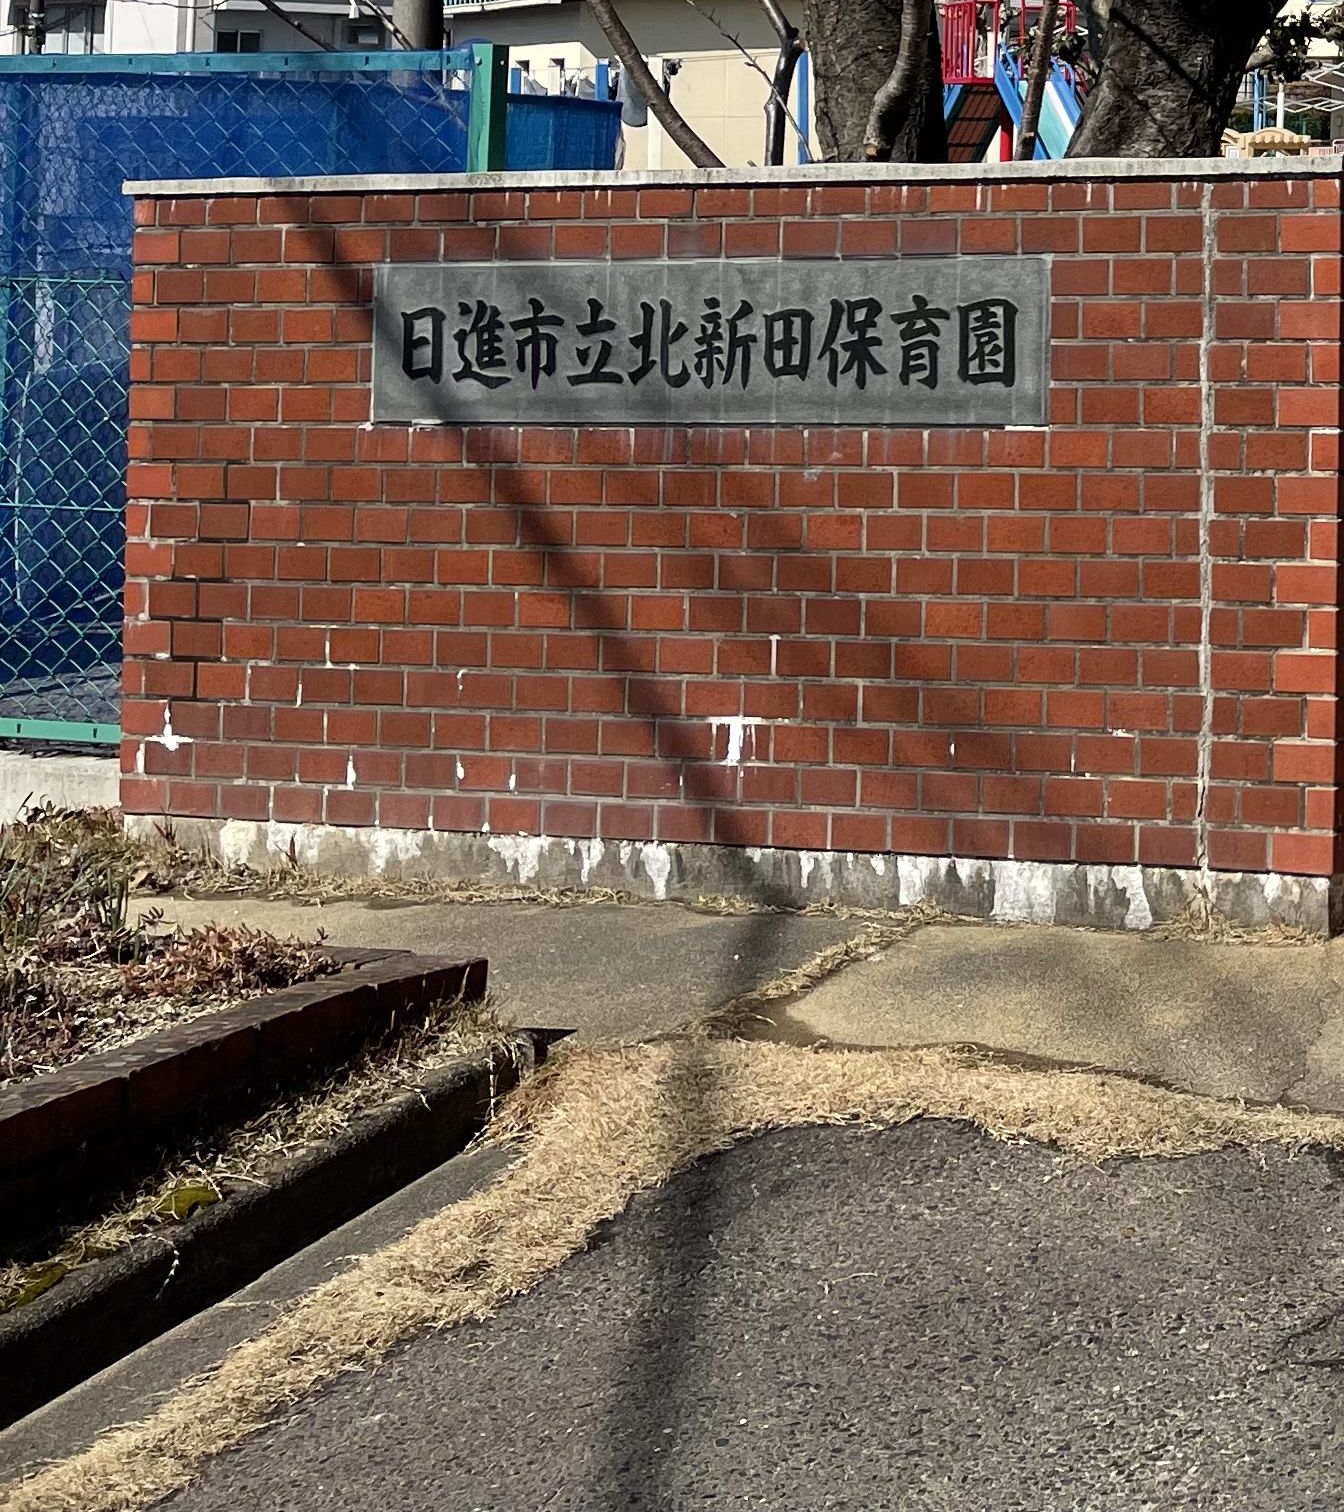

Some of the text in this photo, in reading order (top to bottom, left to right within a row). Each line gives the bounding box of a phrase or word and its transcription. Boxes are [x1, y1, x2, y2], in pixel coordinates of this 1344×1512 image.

[399, 294, 1019, 391] 日進市立北新田保育園
